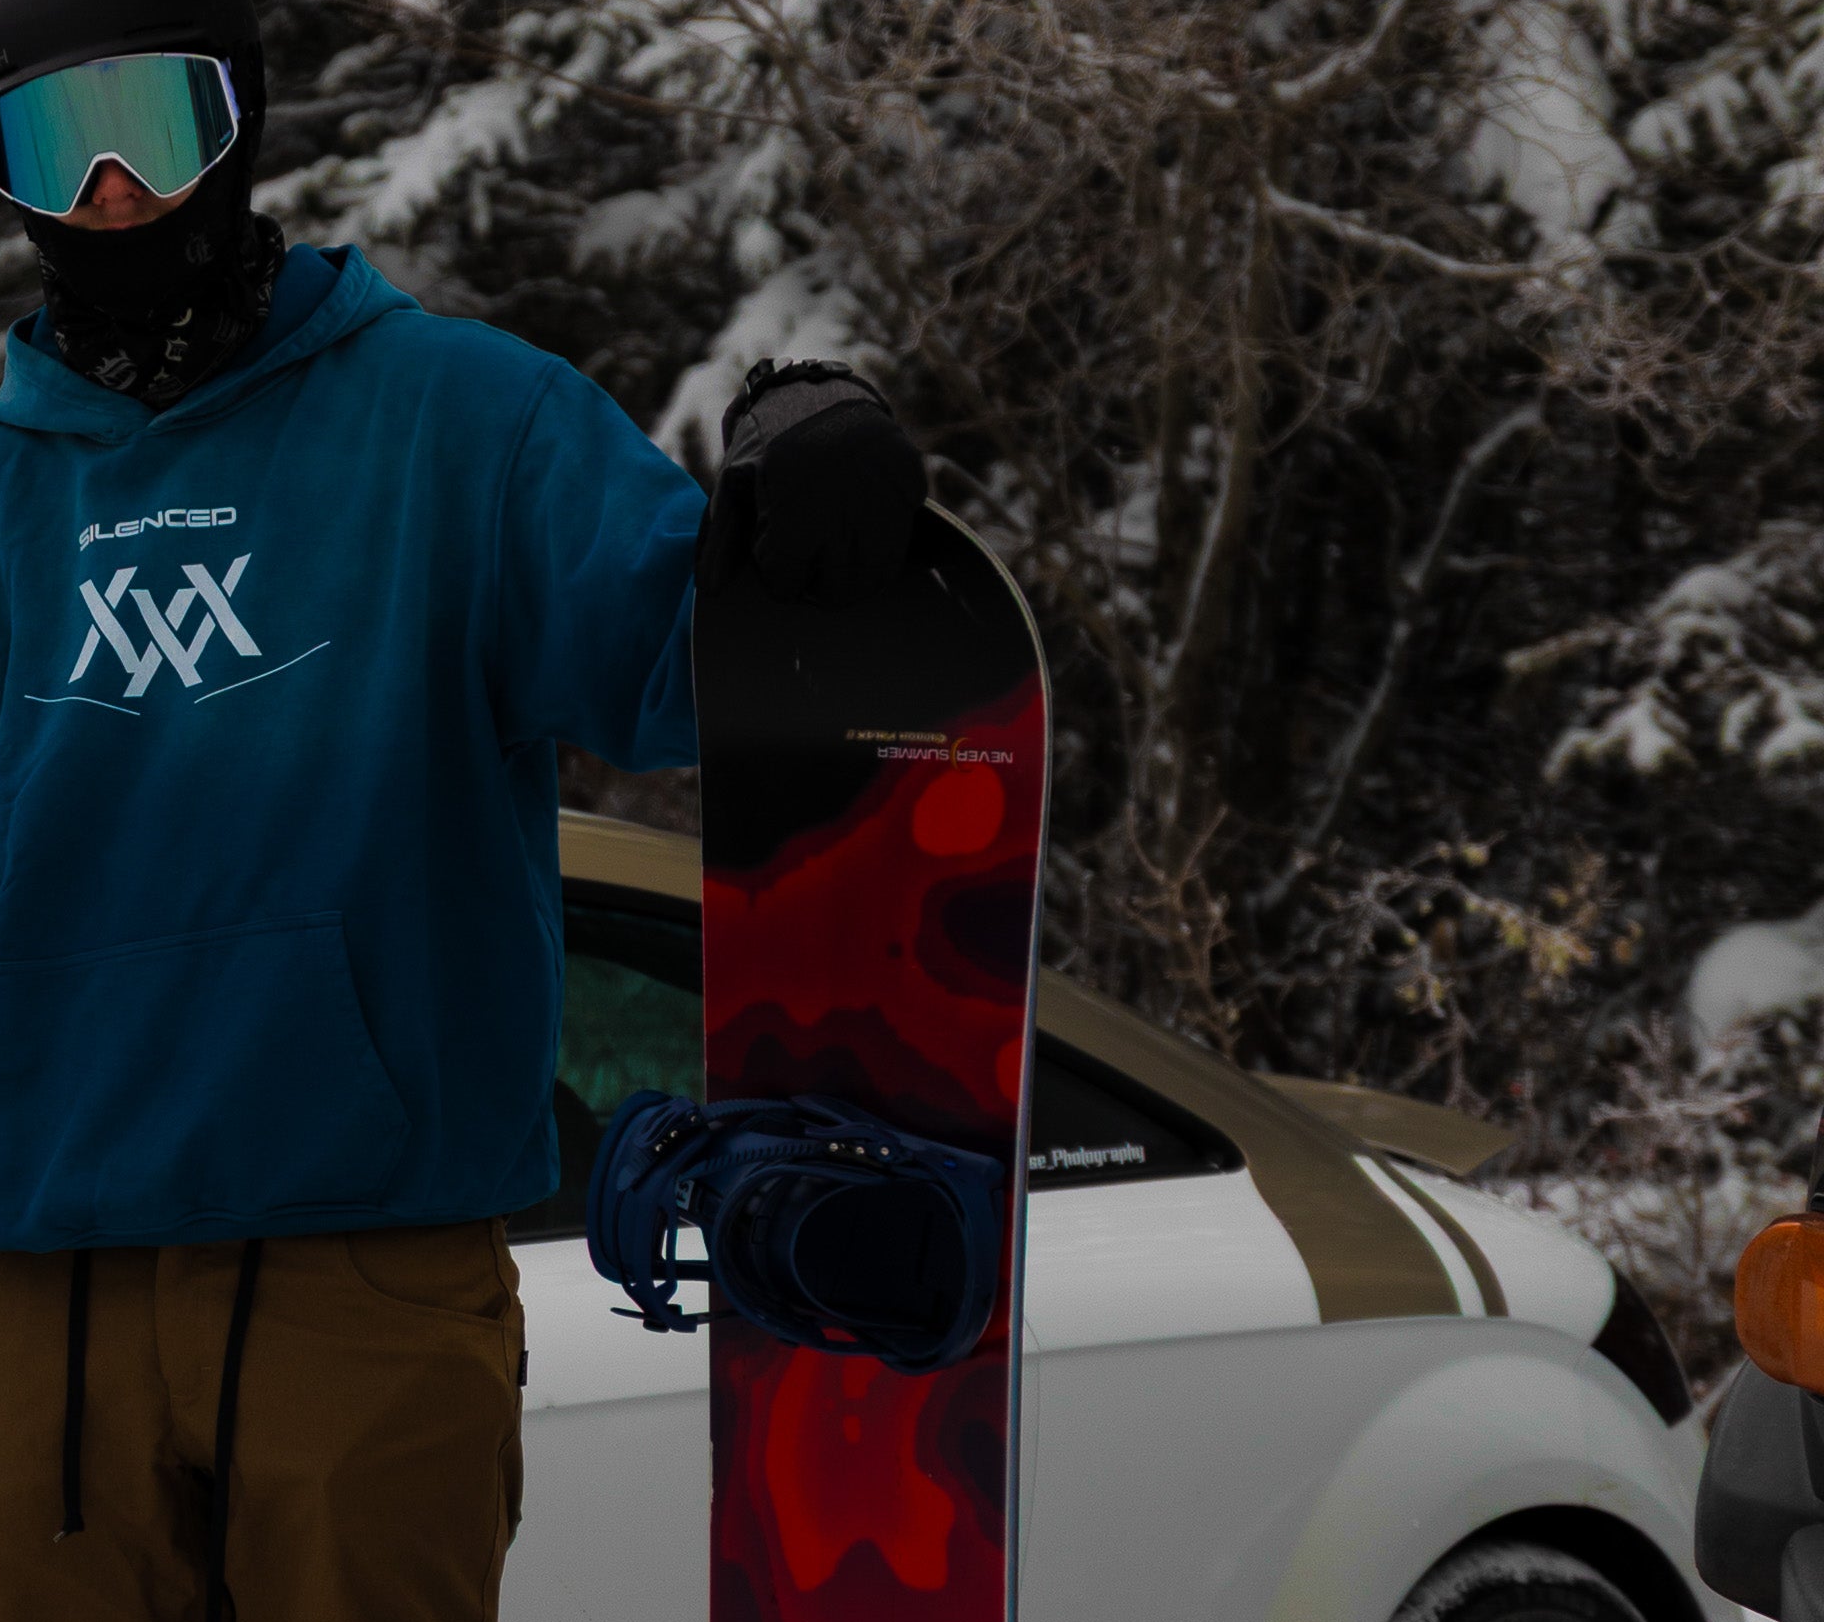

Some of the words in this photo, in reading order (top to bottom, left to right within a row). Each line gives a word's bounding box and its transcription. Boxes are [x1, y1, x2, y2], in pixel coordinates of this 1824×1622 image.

[78, 506, 237, 551] SILENCED
[877, 746, 950, 762] SUMMER
[956, 750, 1014, 764] NEVER
